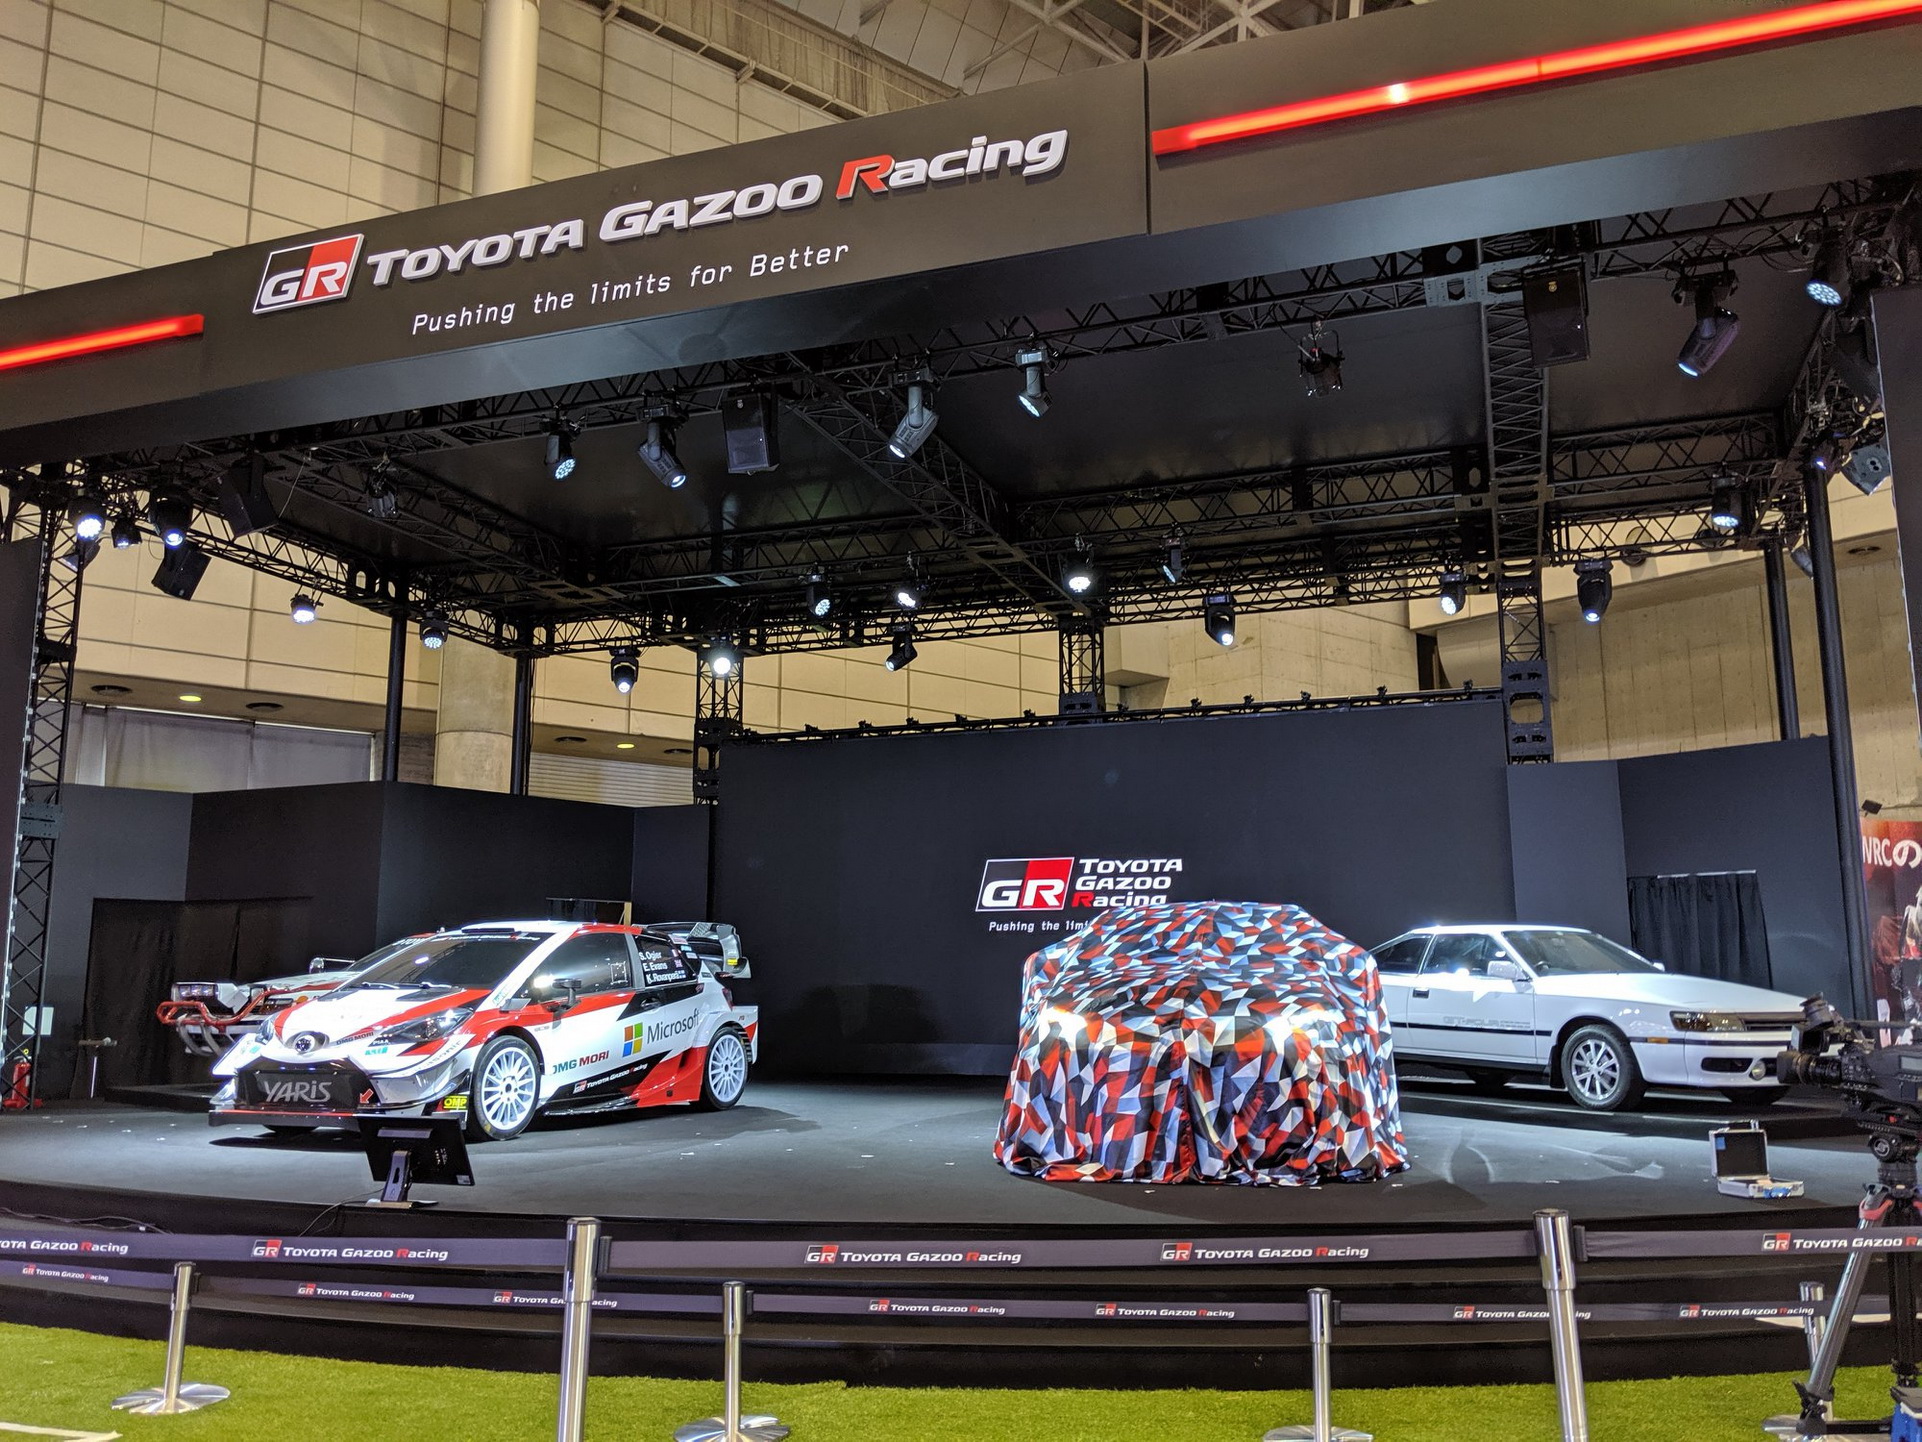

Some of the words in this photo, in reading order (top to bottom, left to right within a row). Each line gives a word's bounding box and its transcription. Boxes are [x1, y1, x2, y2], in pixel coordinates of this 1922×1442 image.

[260, 261, 347, 305] GR
[367, 219, 583, 286] TOYOTA
[600, 174, 823, 241] GAZOO
[836, 129, 1068, 199] Racing
[413, 301, 514, 335] Pushing
[534, 290, 573, 314] the
[590, 272, 671, 305] limits
[691, 263, 732, 287] for
[750, 243, 849, 276] Better
[1079, 858, 1183, 874] TOYOTA
[1075, 875, 1172, 891] GAZOO
[981, 879, 1065, 907] GR
[1072, 892, 1167, 908] Racing
[989, 921, 1034, 933] Pushing
[1041, 921, 1060, 931] the
[647, 1008, 700, 1044] Microsoft
[579, 1050, 609, 1067] MORI
[444, 1097, 467, 1107] OMP
[30, 1240, 78, 1251] GAZOO
[81, 1241, 129, 1255] Racing
[1763, 1239, 1789, 1250] GR
[1793, 1239, 1848, 1249] TOYOTA
[1852, 1237, 1903, 1248] GAZOO
[253, 1246, 279, 1258] GR
[283, 1247, 338, 1257] TOYOTA
[341, 1248, 394, 1258] GAZOO
[396, 1248, 449, 1261] Racing
[806, 1252, 837, 1262] GR
[840, 1252, 901, 1262] TOYOTA
[906, 1252, 963, 1262] GAZOO
[965, 1251, 1022, 1264] Racing
[1162, 1249, 1190, 1260] GR
[1195, 1249, 1254, 1259] TOYOTA
[1258, 1247, 1313, 1258] GAZOO
[1315, 1245, 1369, 1258] Racing
[36, 1267, 60, 1277] TOYOTA
[61, 1270, 85, 1279] GAZOO
[85, 1272, 109, 1283] Racing
[316, 1287, 349, 1297] TOYOTA
[351, 1289, 383, 1298] GAZOO
[383, 1290, 415, 1300] Racing
[513, 1296, 548, 1304] TOYOTA
[891, 1304, 929, 1312] TOYOTA
[932, 1304, 968, 1313] GAZOO
[969, 1305, 1006, 1315] Racing
[1118, 1308, 1157, 1316] TOYOTA
[1159, 1308, 1197, 1317] GAZOO
[1198, 1309, 1235, 1318] Racing
[1476, 1310, 1515, 1318] TOYOTA
[1701, 1308, 1740, 1317] TOYOTA
[1742, 1307, 1778, 1316] GAZOO
[1779, 1307, 1814, 1316] Racing
